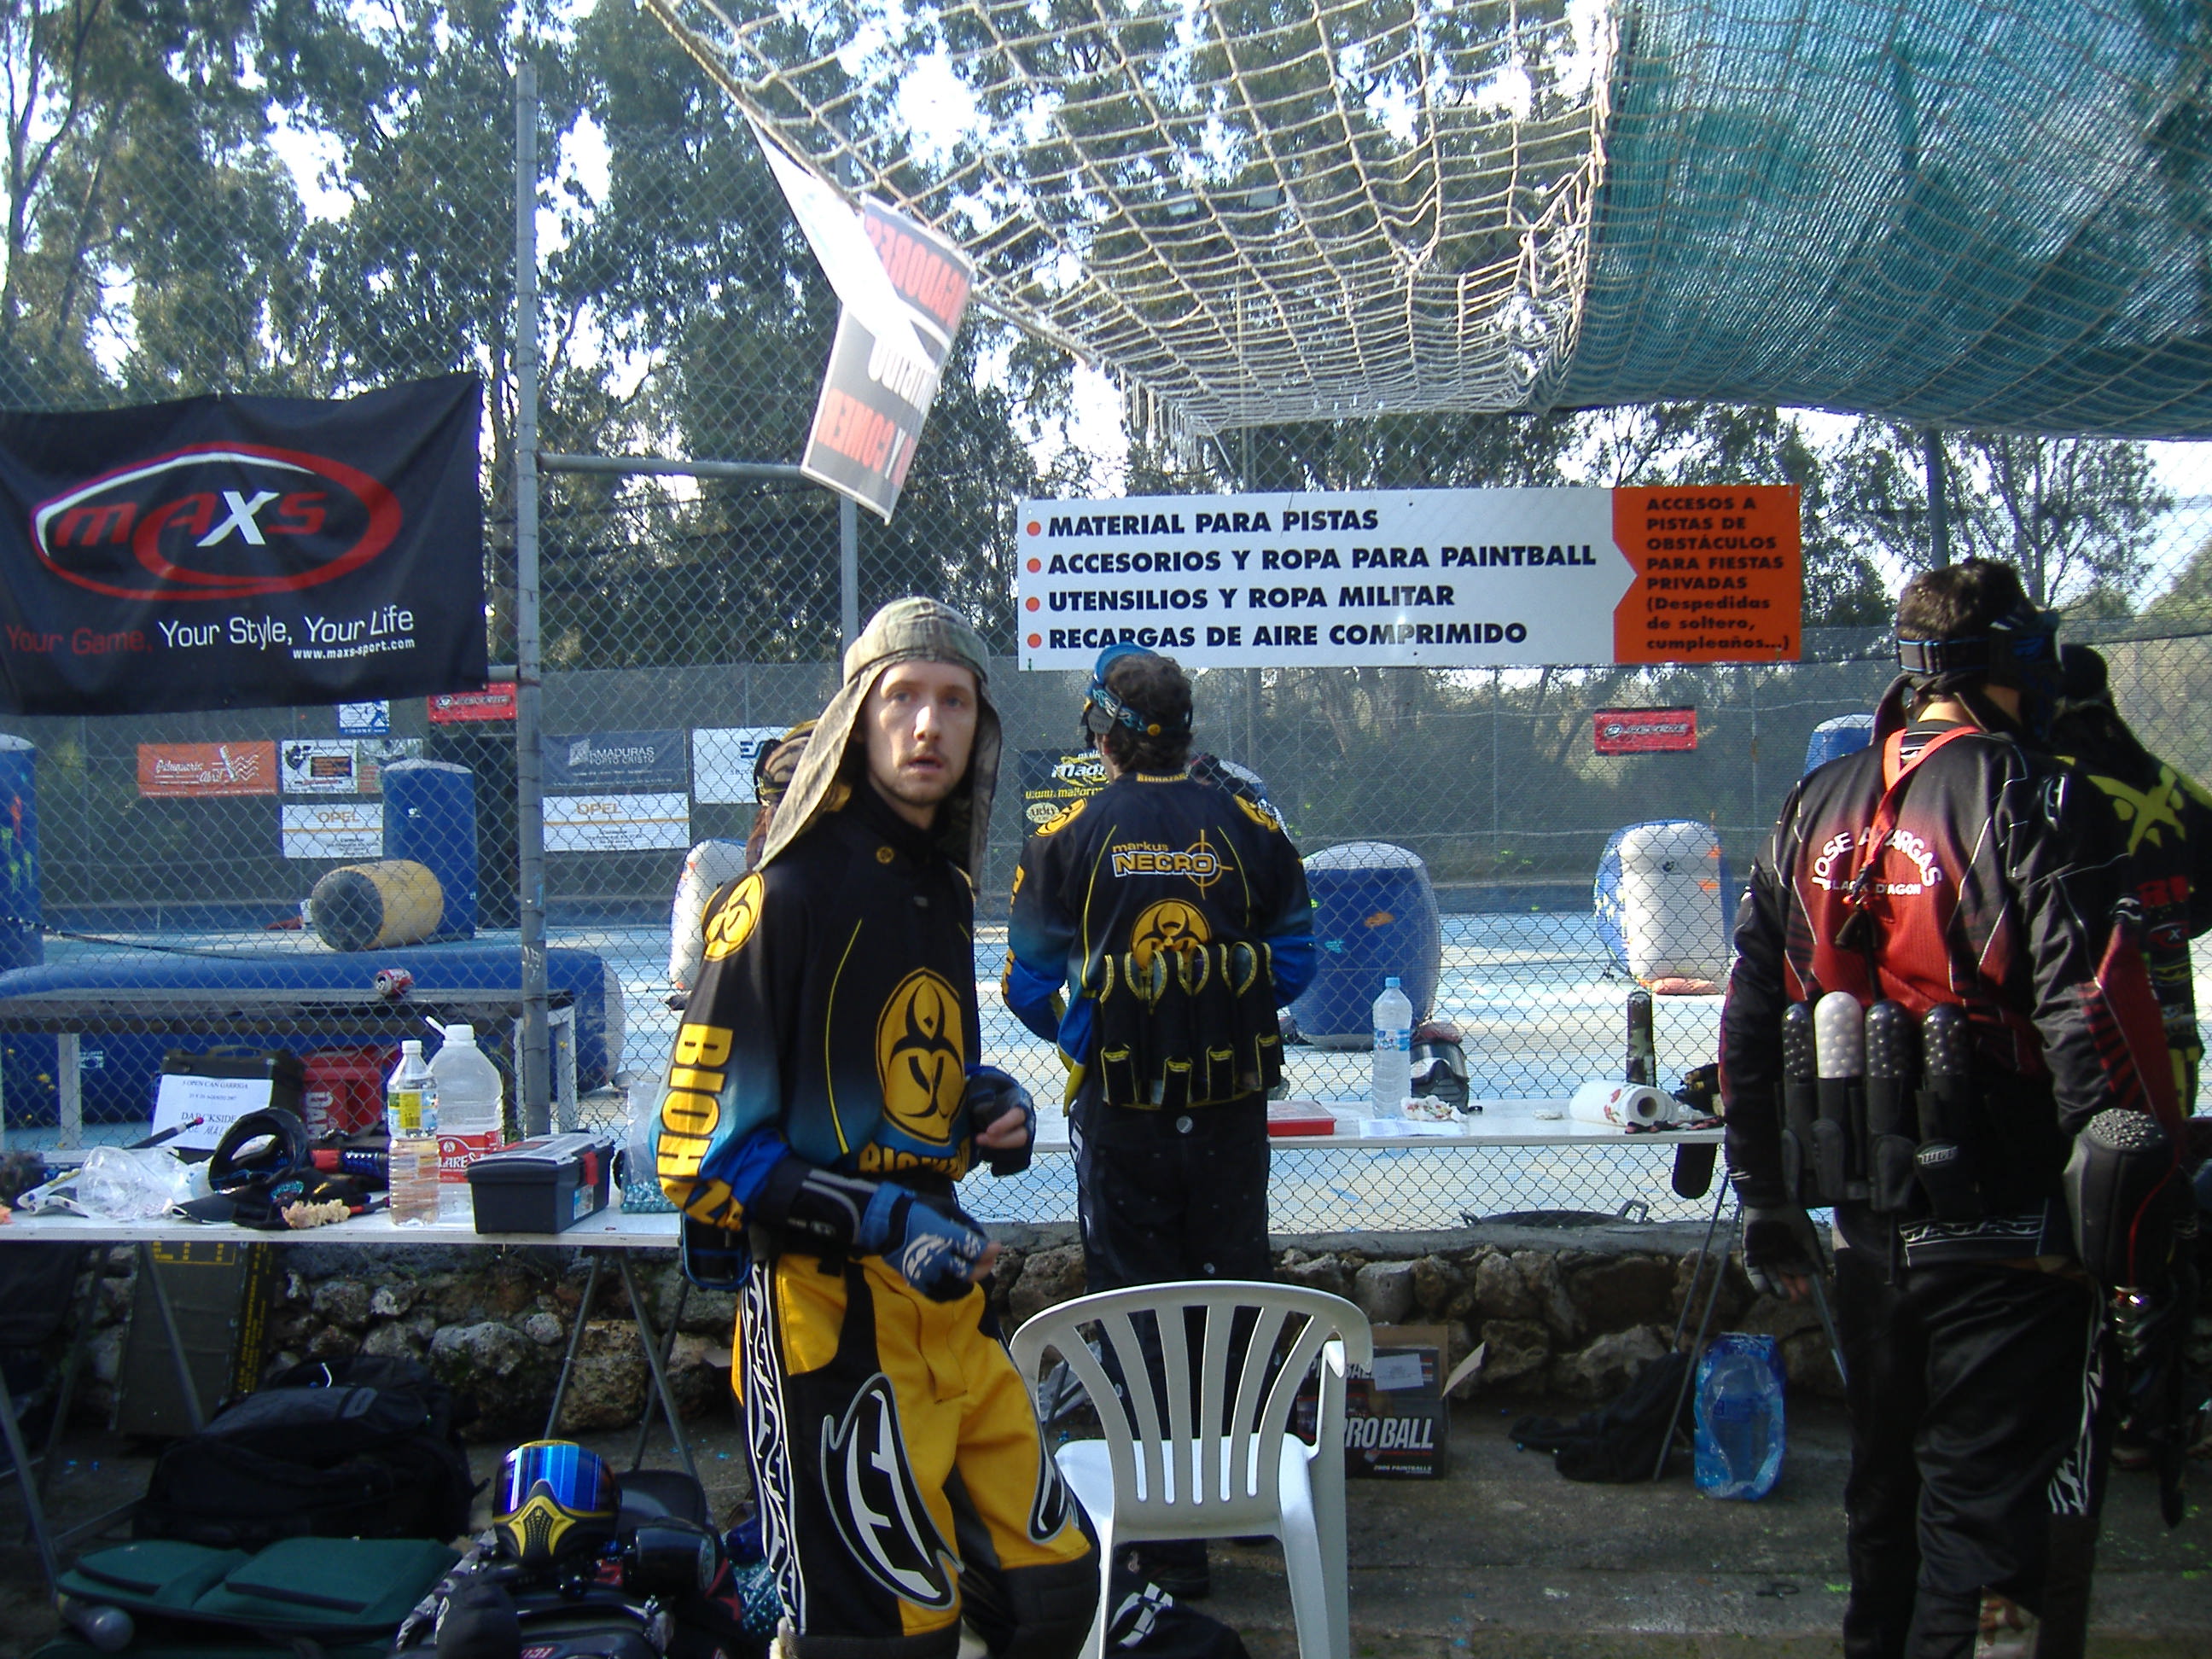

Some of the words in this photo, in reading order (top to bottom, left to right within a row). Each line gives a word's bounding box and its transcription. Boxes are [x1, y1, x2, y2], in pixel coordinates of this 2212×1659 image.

[1646, 498, 1734, 511] ACCESOS
[1743, 498, 1756, 509] A
[1048, 515, 1185, 537] MATERIAL
[1196, 512, 1272, 533] PARA
[1283, 509, 1378, 531] PISTAS
[1646, 517, 1714, 531] PISTAS
[1721, 517, 1746, 530] DE
[1646, 534, 1777, 550] OBSTÁCULOS
[1048, 550, 1220, 574] ACCESORIOS
[1231, 550, 1250, 570] Y
[1262, 548, 1341, 569] ROPA
[1352, 547, 1430, 568] PARA
[1441, 545, 1597, 567] PAINTBALL
[1646, 557, 1700, 570] PARA
[1708, 556, 1784, 569] FIESTAS
[1646, 577, 1748, 590] PRIVADAS
[1049, 589, 1208, 611] UTENSILIOS
[1219, 589, 1237, 608] Y
[1249, 586, 1328, 608] ROPA
[1338, 585, 1454, 607] MILITAR
[1646, 596, 1770, 613] (Despedidas
[6, 624, 63, 653] Your
[158, 618, 220, 648] Your
[229, 614, 293, 650] Style,
[305, 614, 364, 643] Your
[370, 604, 415, 636] Life
[1646, 616, 1670, 630] de
[1679, 616, 1755, 632] soltero,
[1049, 626, 1196, 649] RECARGAS
[1207, 626, 1242, 647] DE
[1252, 625, 1318, 646] AIRE
[1329, 623, 1528, 645] COMPRIMIDO
[292, 637, 416, 660] www.maxs-sport.com
[317, 811, 361, 823] OPEL
[1112, 841, 1169, 853] markus
[1812, 831, 1854, 890] JOSE
